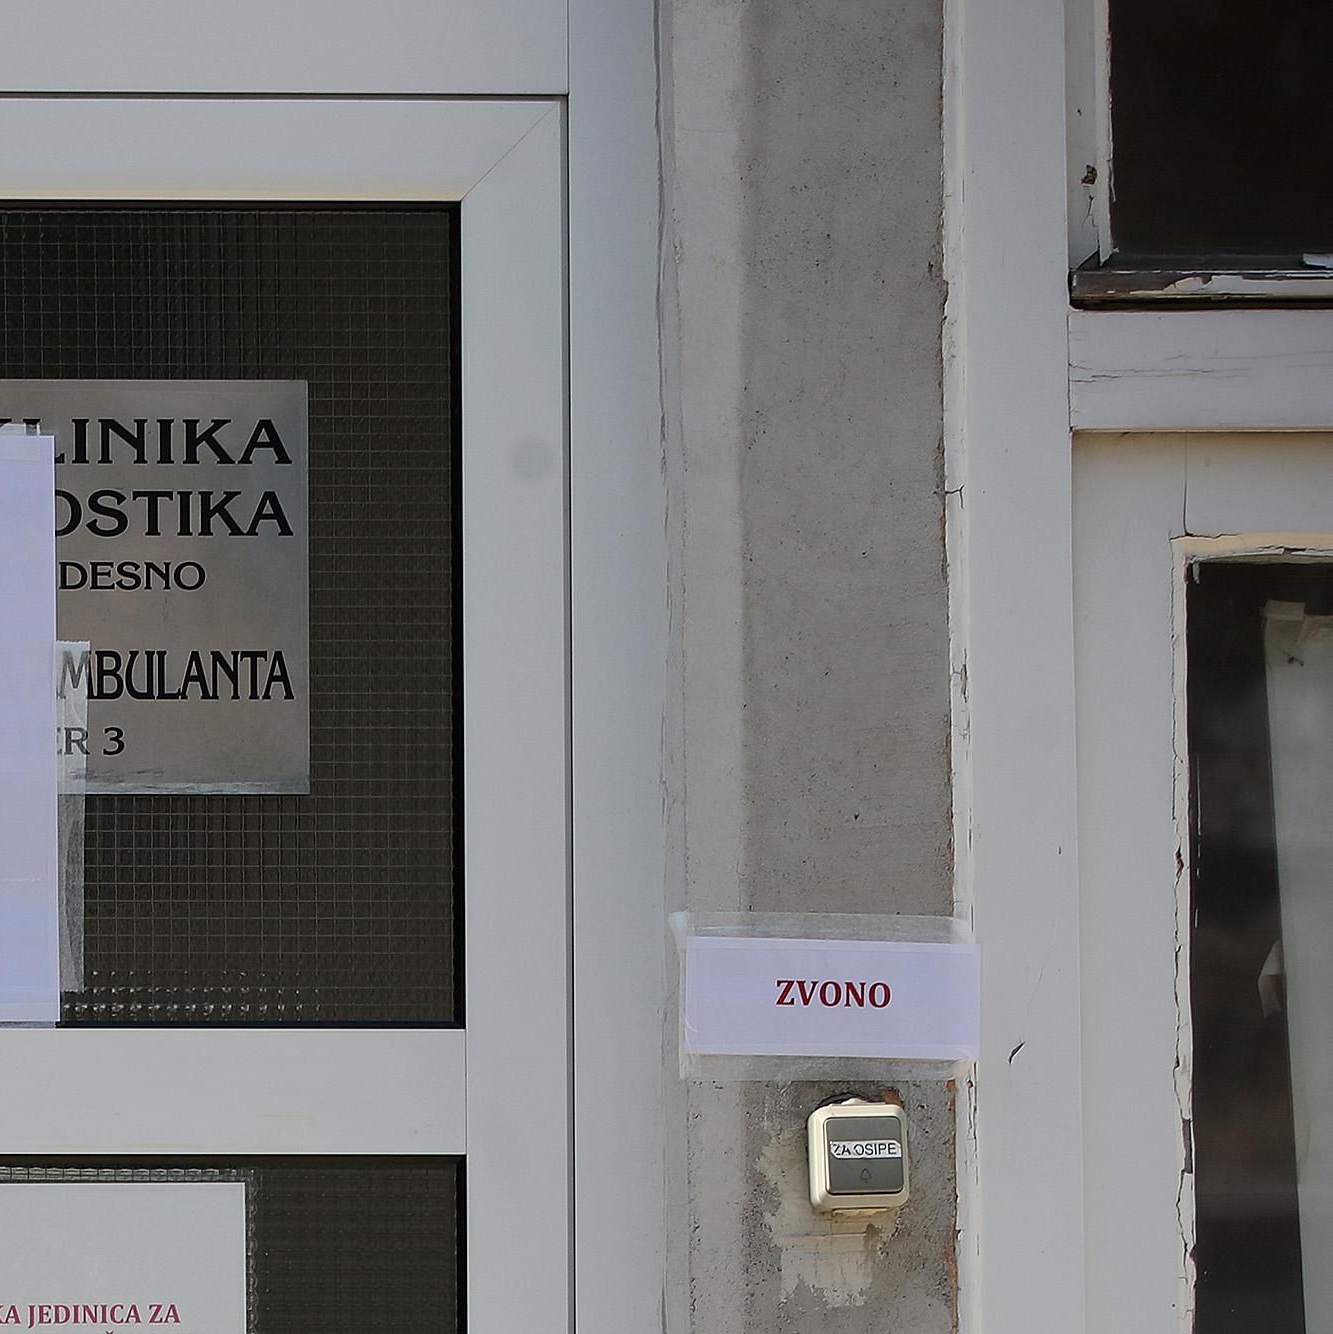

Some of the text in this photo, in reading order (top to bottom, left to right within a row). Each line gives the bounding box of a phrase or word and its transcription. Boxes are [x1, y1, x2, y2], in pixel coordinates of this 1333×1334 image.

[58, 560, 206, 592] DESNO
[102, 726, 126, 756] 3
[775, 979, 891, 1009] ZVONO
[853, 1142, 898, 1156] OSIPE
[27, 1304, 142, 1329] JEDINICA
[148, 1304, 181, 1324] ZA
